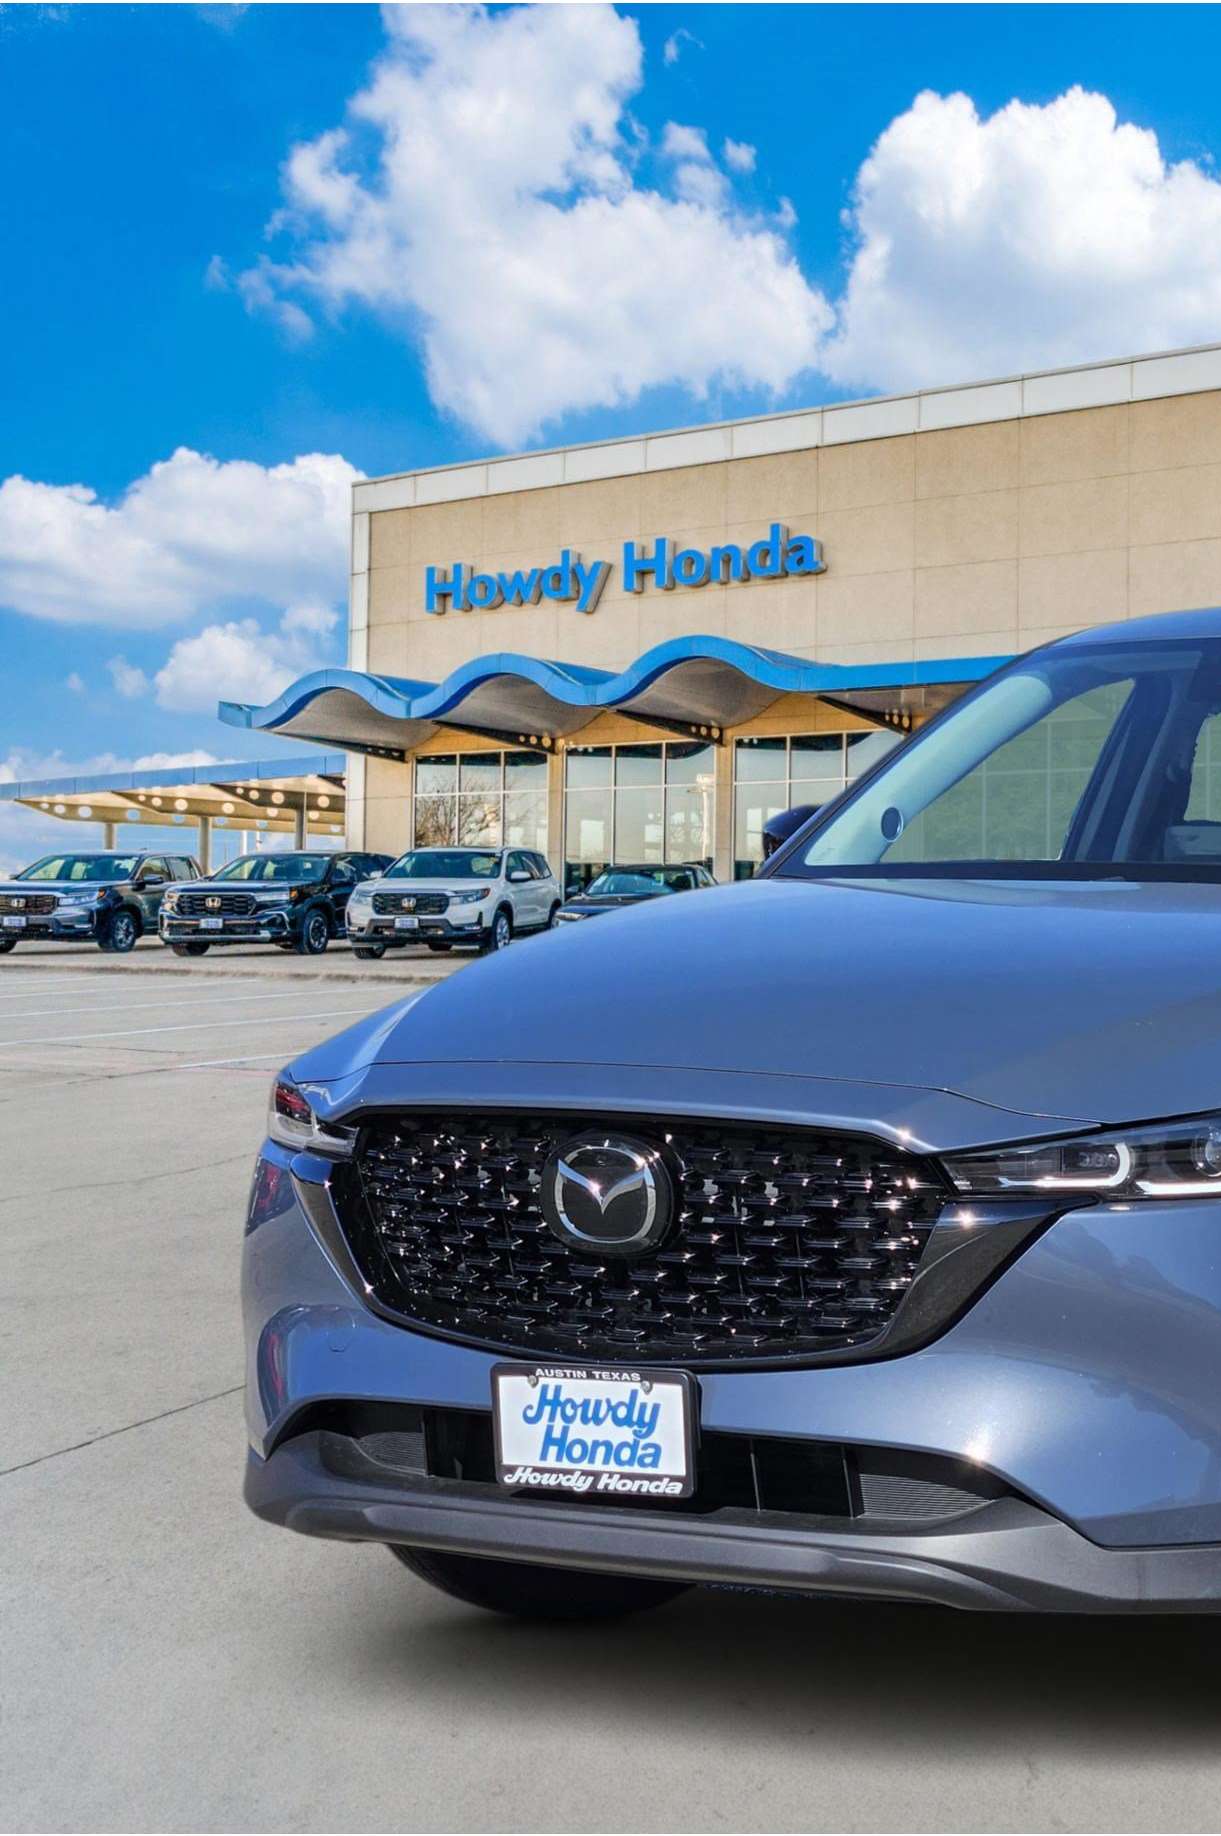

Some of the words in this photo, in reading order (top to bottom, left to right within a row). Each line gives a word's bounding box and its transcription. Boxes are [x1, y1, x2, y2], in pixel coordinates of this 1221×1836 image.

[424, 549, 612, 614] Howdy
[623, 523, 827, 593] Honda
[535, 1368, 588, 1379] AUSTIN
[592, 1370, 641, 1382] TEXAS
[522, 1384, 661, 1440] Howdy
[539, 1424, 663, 1469] Honda
[503, 1466, 595, 1492] Howdy
[596, 1470, 684, 1495] Honda
